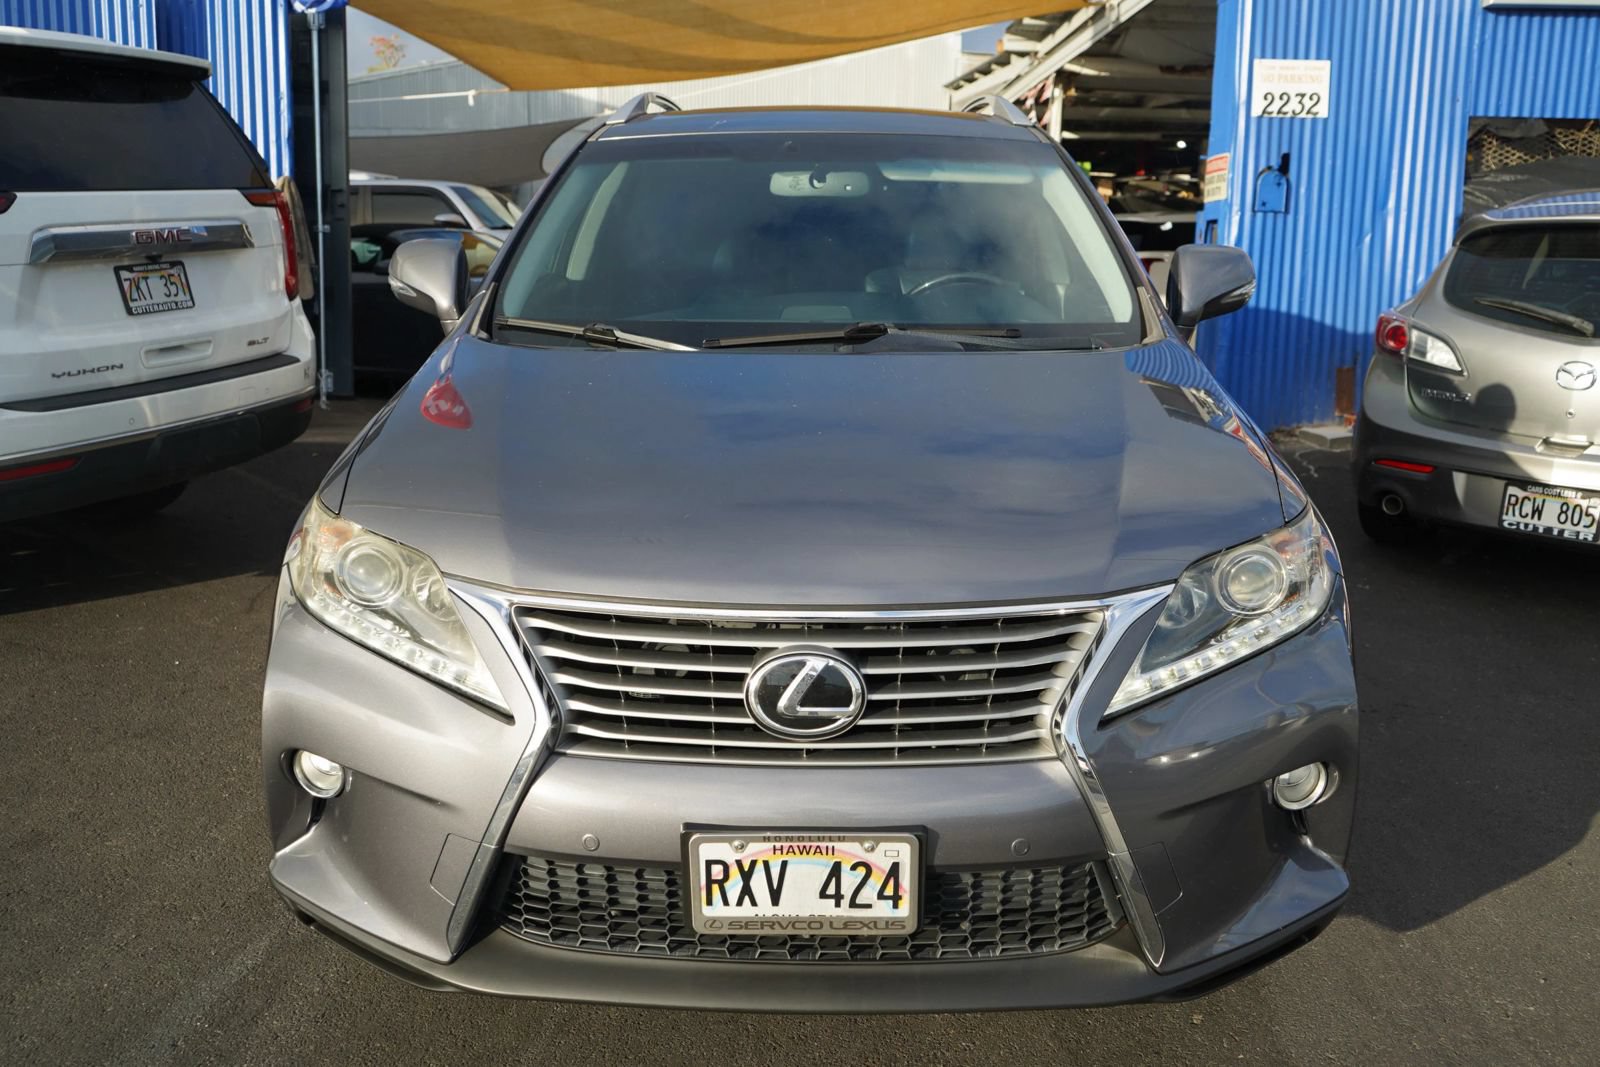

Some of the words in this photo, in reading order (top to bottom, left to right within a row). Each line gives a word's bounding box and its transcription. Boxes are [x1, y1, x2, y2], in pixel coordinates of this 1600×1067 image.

[1277, 74, 1323, 83] PARKING
[1261, 92, 1321, 117] 2232
[132, 229, 193, 245] GMC
[123, 276, 153, 303] ZKT
[159, 273, 187, 298] 351
[132, 300, 193, 314] CUTTERAUTO.COM
[51, 363, 124, 379] YUKON
[1505, 493, 1546, 521] RCW
[1557, 502, 1598, 529] 805
[1502, 520, 1594, 542] CUTTER
[763, 834, 846, 843] HONOLULU
[772, 844, 835, 856] HAWAII
[704, 859, 788, 907] RXV
[818, 860, 902, 909] 424
[728, 920, 824, 931] SERVCO
[829, 920, 906, 931] LEXUS
